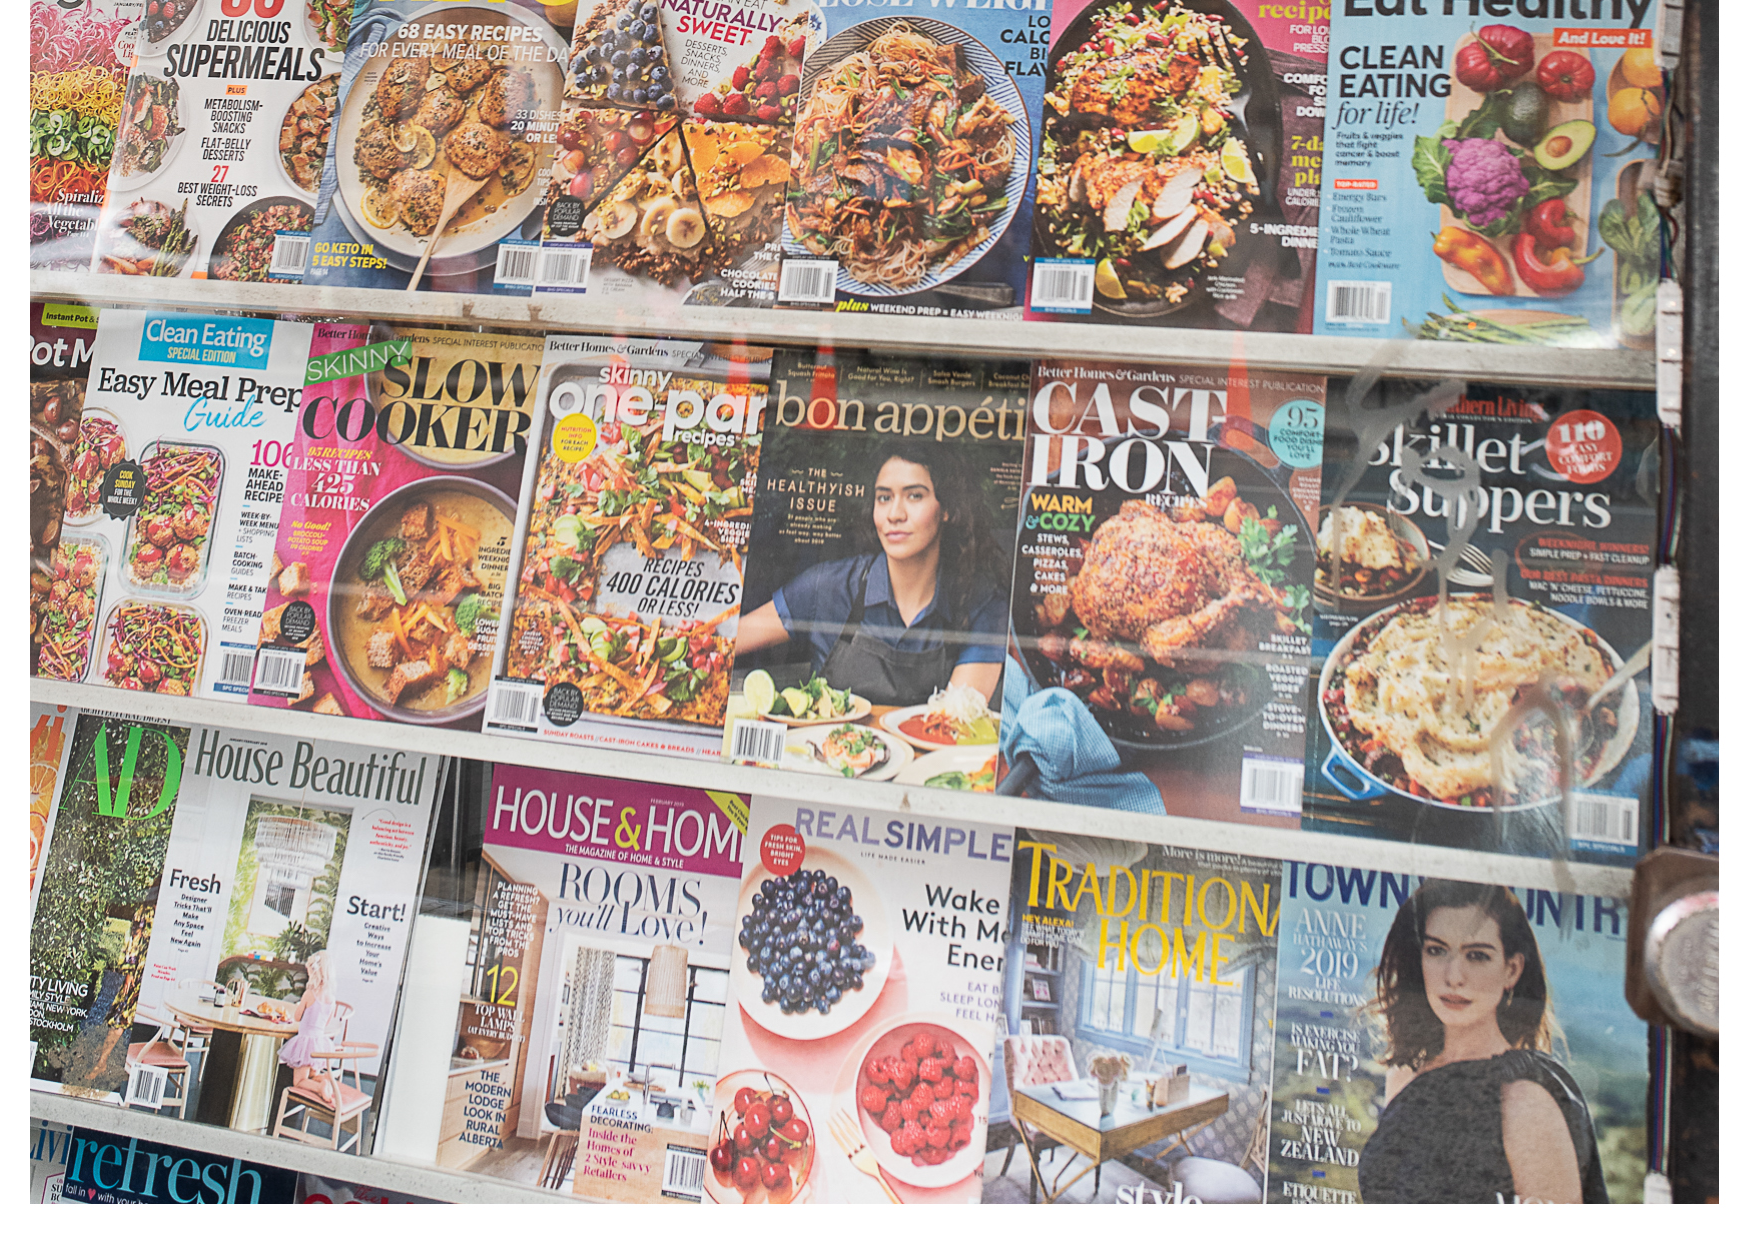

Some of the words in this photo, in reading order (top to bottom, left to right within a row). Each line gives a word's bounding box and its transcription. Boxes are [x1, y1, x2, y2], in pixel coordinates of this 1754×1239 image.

[206, 19, 292, 43] DELICIOUS
[398, 24, 418, 41] 68
[423, 24, 460, 40] EASY
[464, 25, 543, 42] RECIPES
[677, 15, 752, 47] SWEET
[163, 43, 324, 82] SUPERMEALS
[1339, 46, 1445, 69] CLEAN
[1339, 74, 1452, 98] EATING
[1333, 102, 1382, 130] for
[1385, 102, 1419, 127] life!
[146, 320, 199, 349] Clean
[202, 326, 267, 358] Eating
[307, 342, 411, 383] SKINNY
[97, 367, 156, 400] Easy
[161, 371, 230, 401] Meal
[237, 379, 303, 410] Prep
[379, 355, 541, 407] SLOW
[184, 395, 267, 432] Guide
[302, 395, 532, 453] COOKER
[808, 468, 826, 478] THE
[1026, 435, 1214, 495] IRON
[790, 495, 838, 513] ISSUE
[643, 558, 704, 578] RECIPES
[606, 571, 642, 596] 400
[645, 575, 740, 603] CALORIES
[637, 598, 657, 613] OR
[660, 599, 699, 617] LESS!
[59, 720, 182, 822] AD
[194, 729, 284, 787] House
[288, 739, 427, 805] Beautiful
[492, 784, 614, 846] HOUSE
[616, 806, 641, 851] &
[796, 808, 881, 844] REAL
[883, 820, 1010, 863] SIMPLE
[878, 853, 895, 861] MADE
[898, 856, 925, 865] EASIER
[169, 868, 222, 896] Fresh
[346, 895, 407, 923] Start!
[619, 901, 707, 947] Love!
[1302, 946, 1357, 980] 2019
[485, 965, 518, 1006] 12
